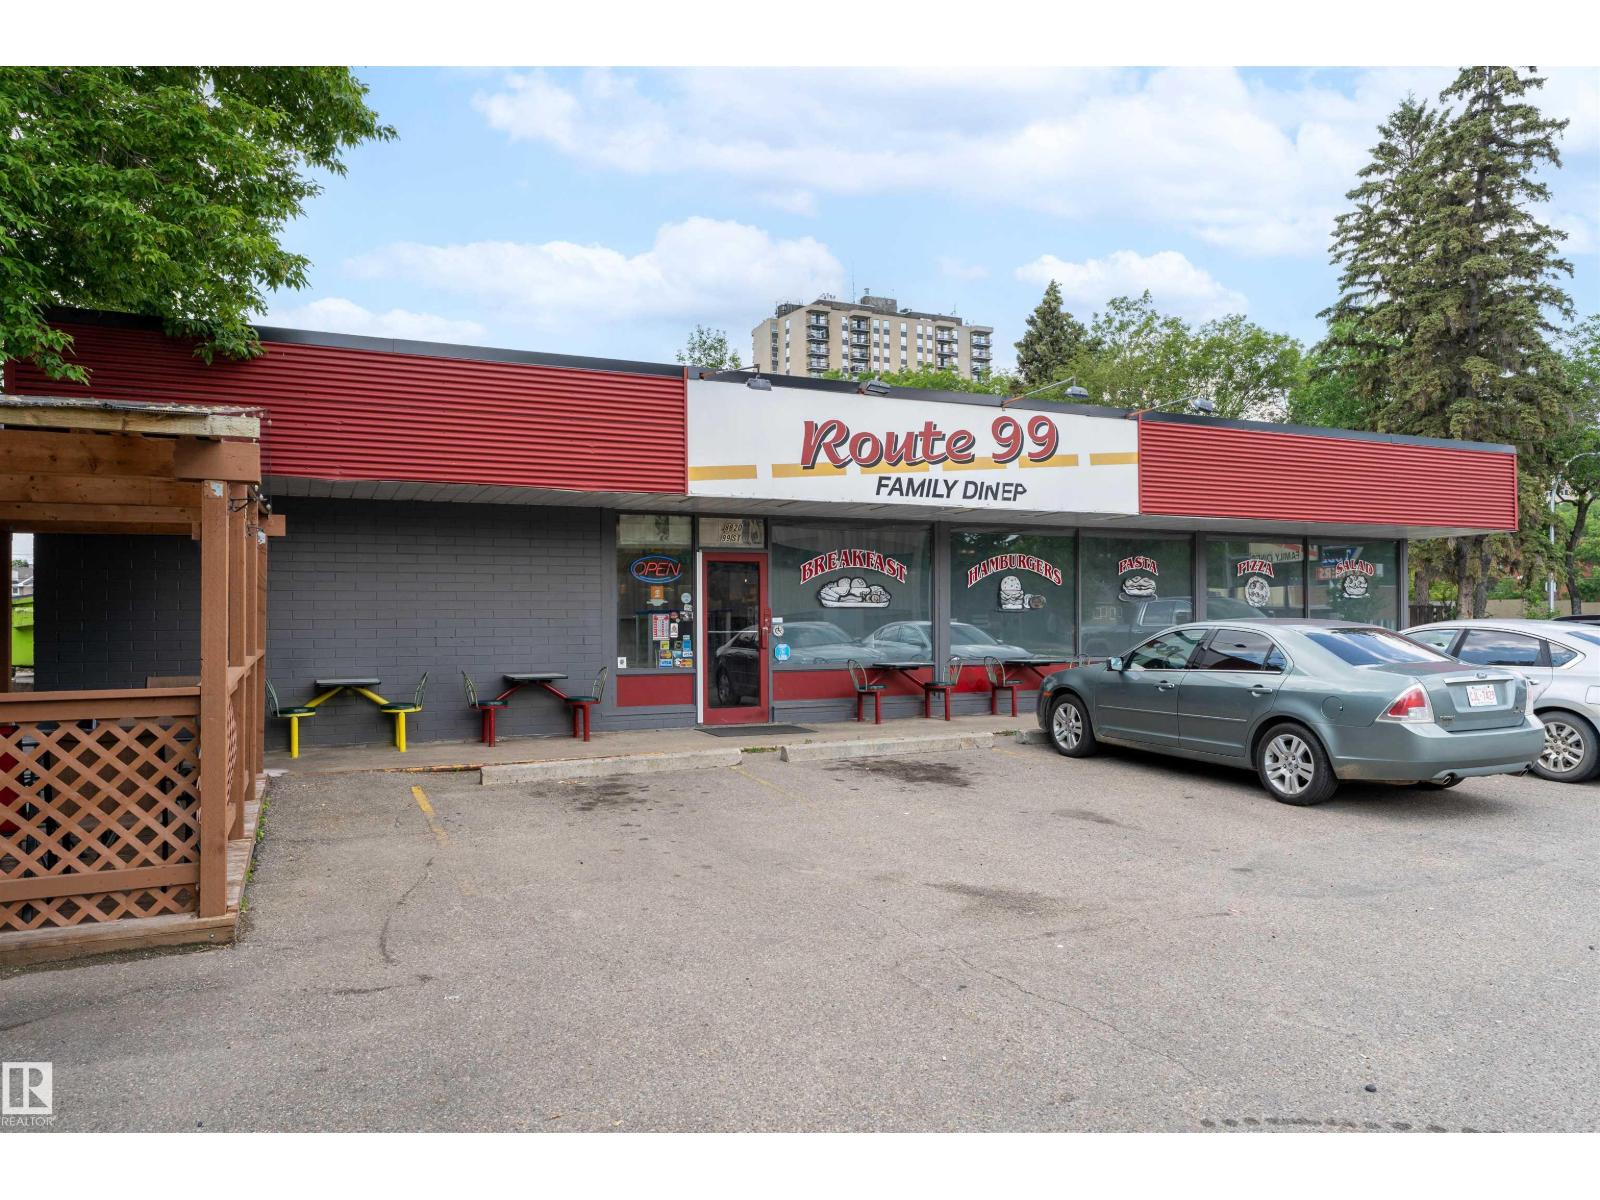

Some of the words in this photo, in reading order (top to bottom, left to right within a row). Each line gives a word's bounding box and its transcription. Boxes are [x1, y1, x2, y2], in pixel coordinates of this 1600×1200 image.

[801, 418, 975, 470] Route
[991, 415, 1059, 463] 99
[875, 475, 960, 499] FAMILY
[633, 561, 681, 577] OPEN
[800, 548, 908, 585] BREAKFAST
[967, 553, 1063, 588] HAMBURGERS
[1118, 554, 1160, 576] PASTA
[1236, 559, 1275, 578] PIZZA
[1333, 559, 1376, 578] SALAD
